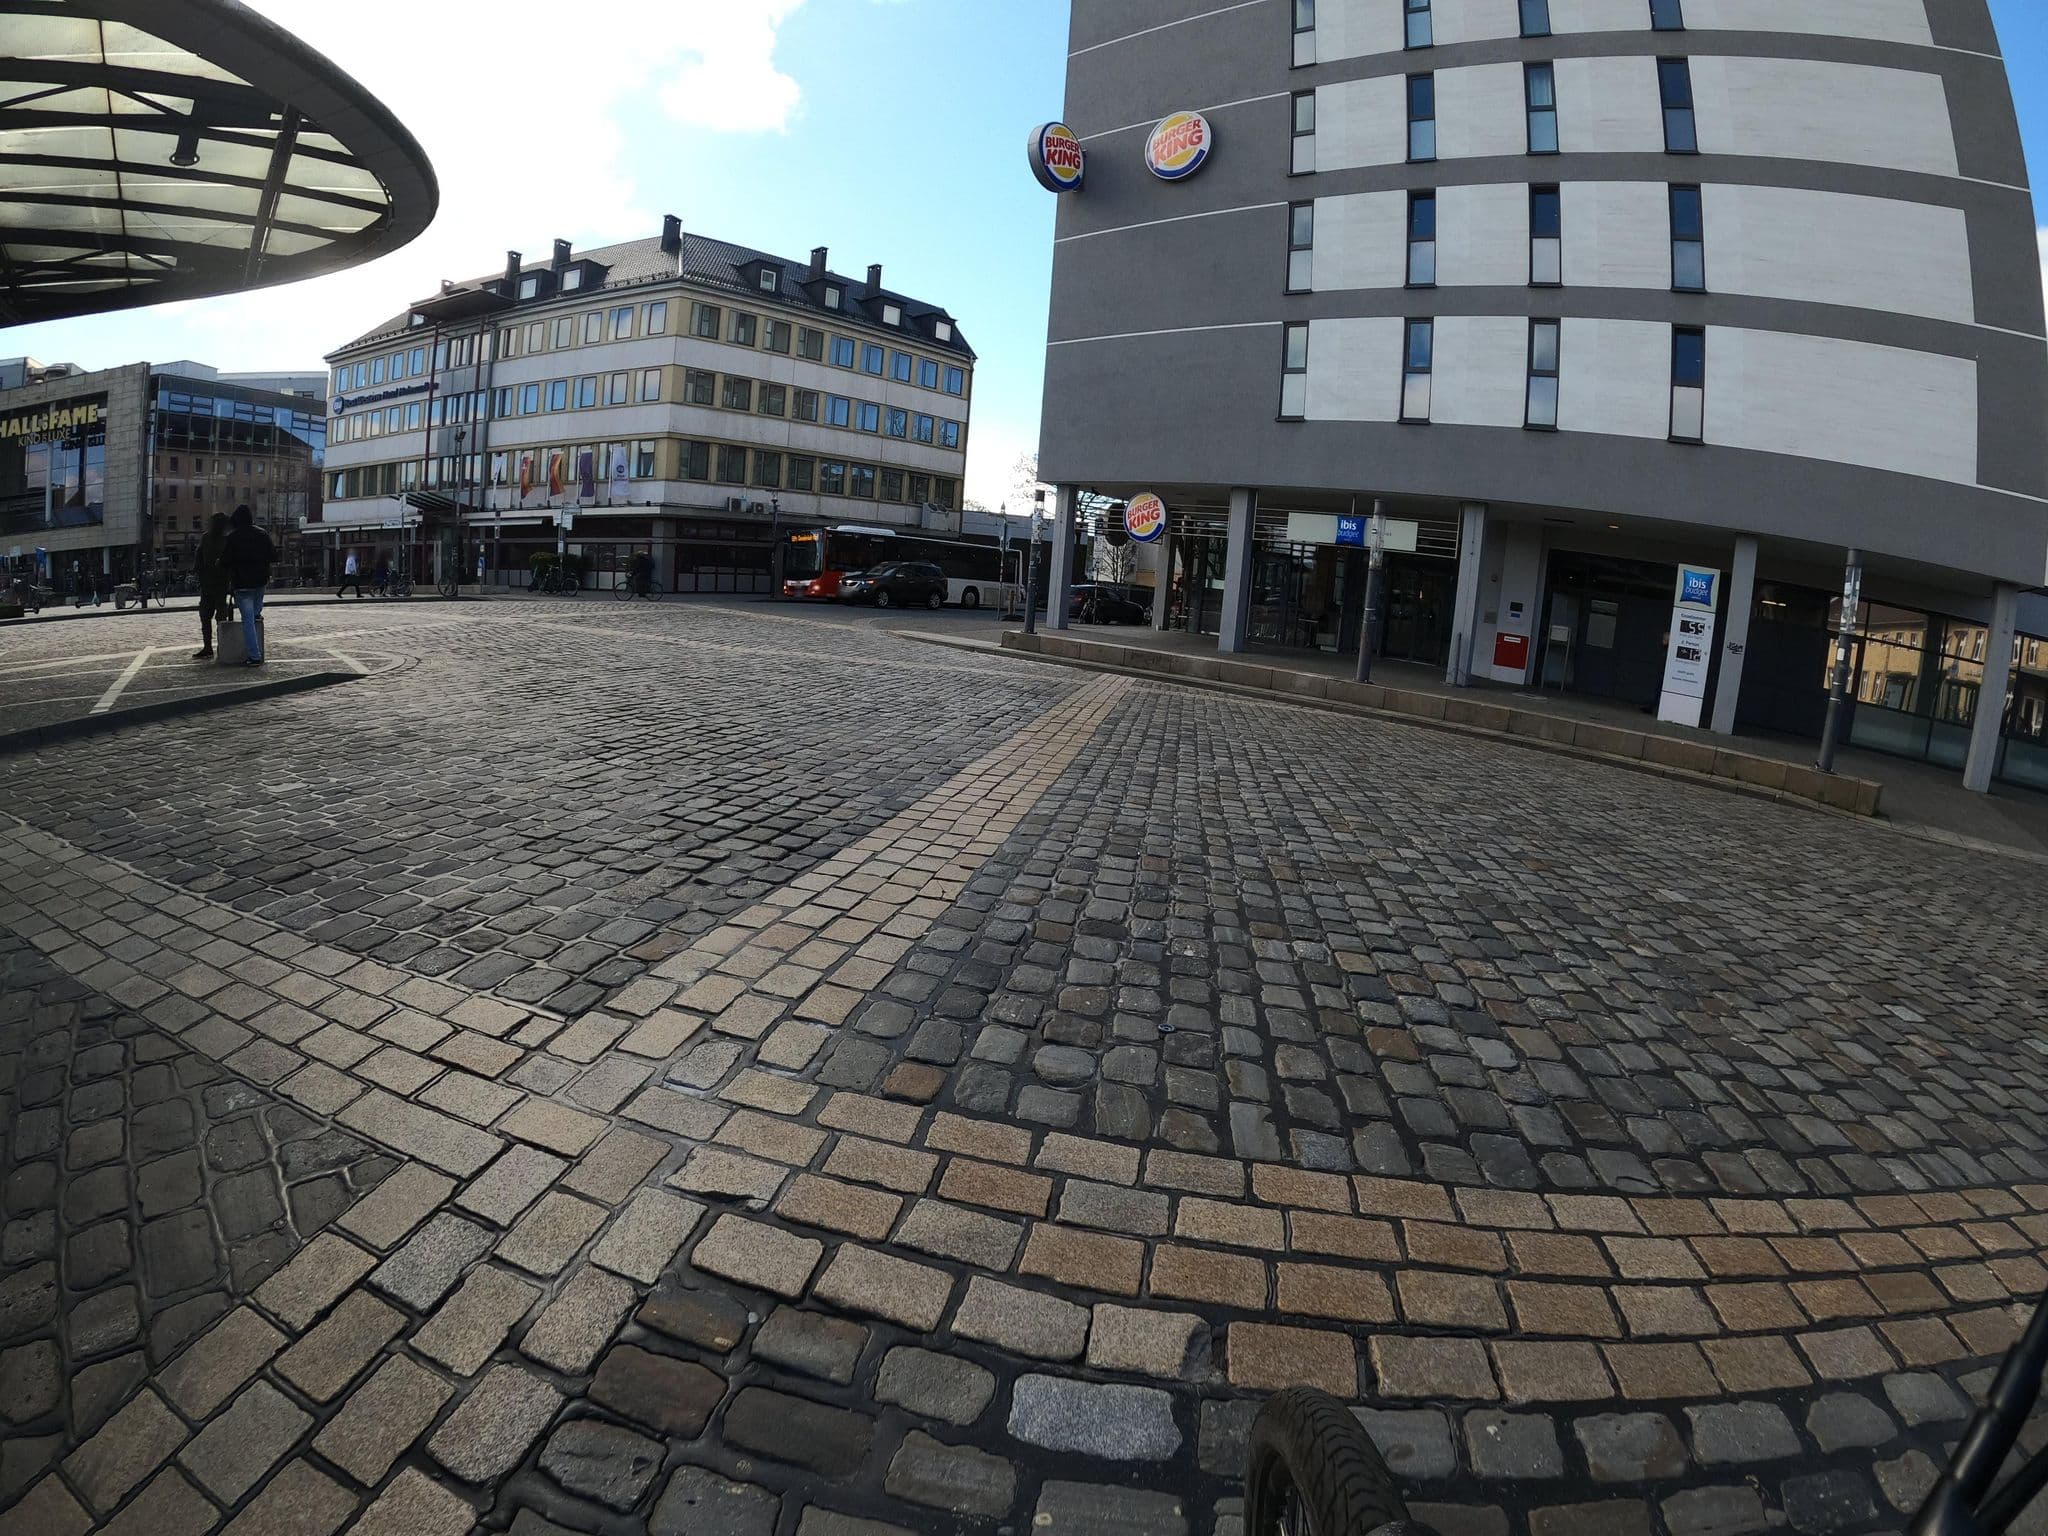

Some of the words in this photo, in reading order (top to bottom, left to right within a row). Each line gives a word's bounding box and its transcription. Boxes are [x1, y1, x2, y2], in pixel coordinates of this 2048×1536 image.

[1045, 136, 1080, 154] BURGER
[1153, 119, 1202, 151] BURGER
[1153, 129, 1203, 166] KING
[1045, 149, 1081, 170] KING
[49, 404, 98, 429] FAME
[1128, 500, 1159, 519] BURGER
[1128, 508, 1160, 531] KING
[1340, 519, 1358, 531] ibis
[1685, 586, 1709, 597] budget
[1689, 576, 1707, 589] ibis
